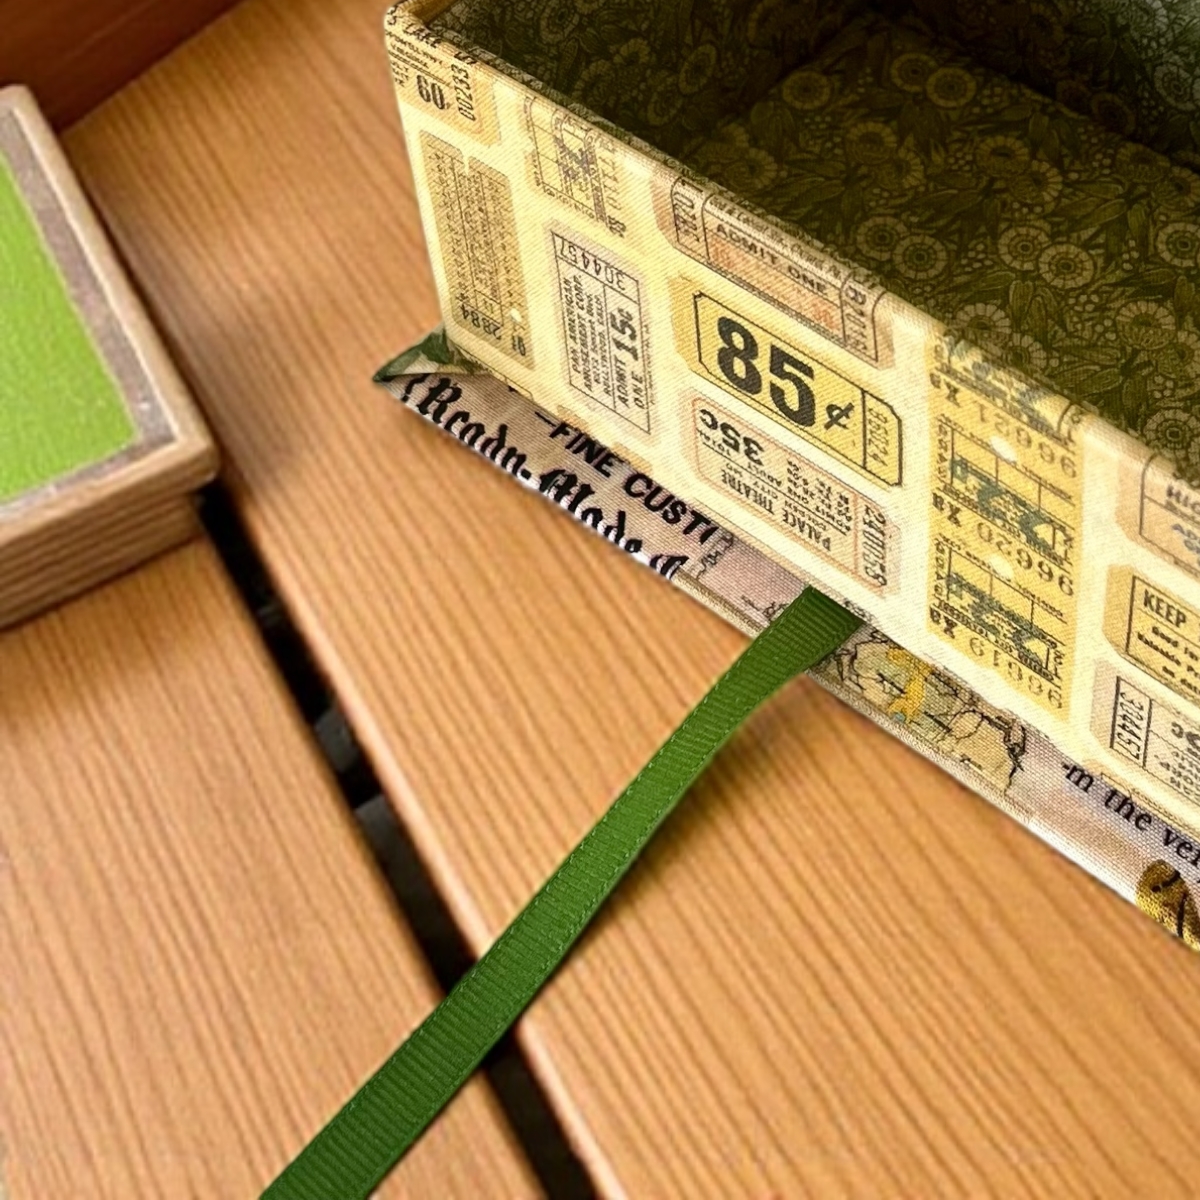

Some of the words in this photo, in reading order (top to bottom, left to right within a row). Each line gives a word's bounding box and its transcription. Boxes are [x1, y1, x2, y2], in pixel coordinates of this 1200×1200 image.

[558, 237, 625, 291] 304457
[716, 221, 778, 267] ADMIT
[788, 263, 826, 296] ONE
[630, 369, 645, 410] ONE
[719, 467, 774, 515] THEATRE
[780, 505, 831, 552] PALACE
[976, 519, 1073, 598] 96620
[1143, 587, 1187, 632] KEEP
[968, 632, 1062, 711] 96619
[1114, 691, 1145, 760] 304457
[1103, 783, 1152, 831] the
